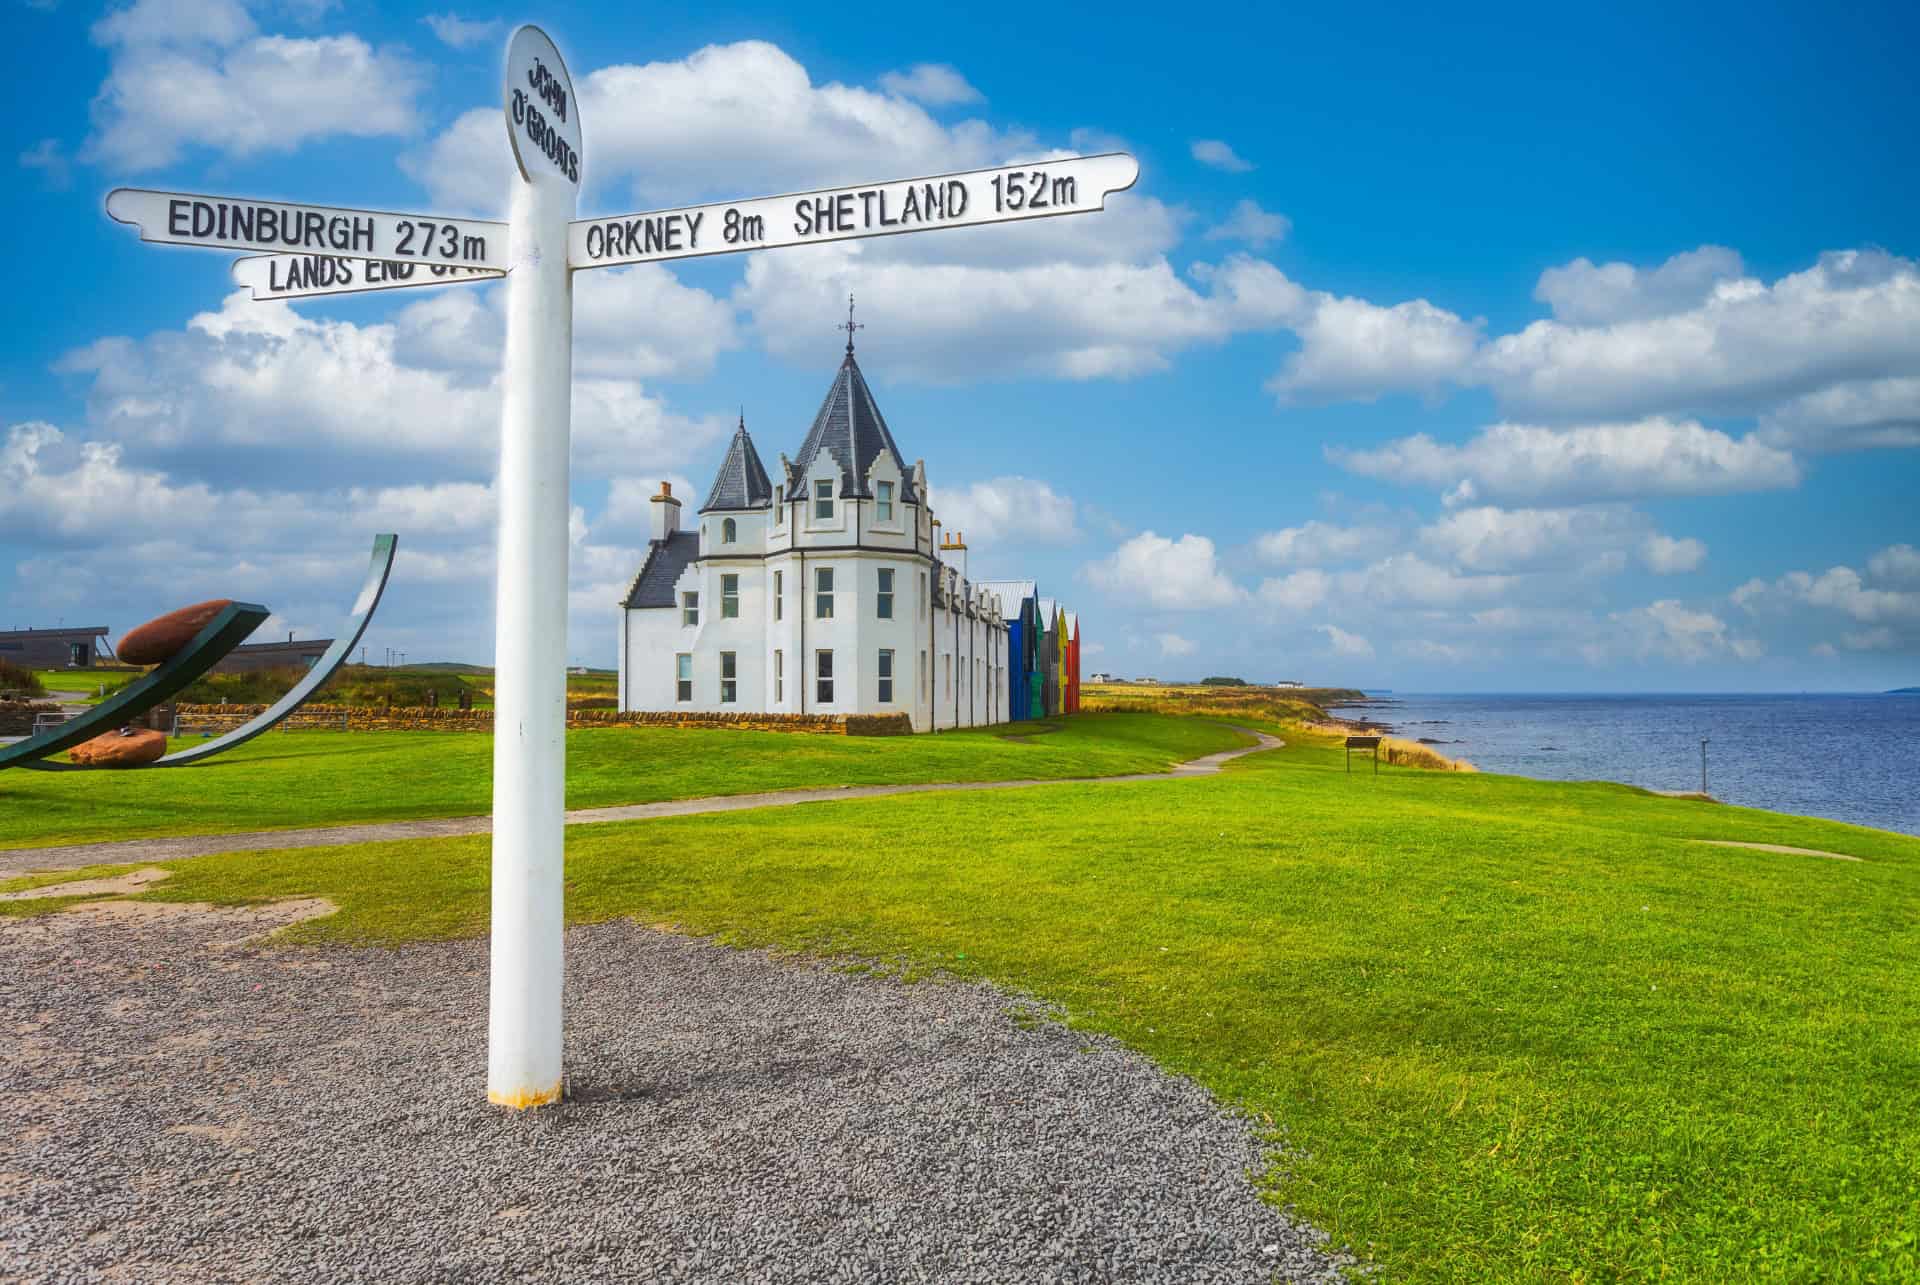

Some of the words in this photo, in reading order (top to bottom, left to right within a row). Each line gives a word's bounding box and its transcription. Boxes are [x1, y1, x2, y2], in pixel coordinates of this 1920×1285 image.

[528, 57, 567, 123] JOHN
[512, 88, 578, 184] O'GROATS
[168, 199, 374, 252] EDINBURGH
[395, 220, 486, 261] 273m
[586, 212, 703, 258] ORKNEY
[723, 208, 764, 244] 8m
[794, 180, 968, 235] SHETLAND
[990, 171, 1076, 213] 152m
[269, 255, 351, 291] LANDS
